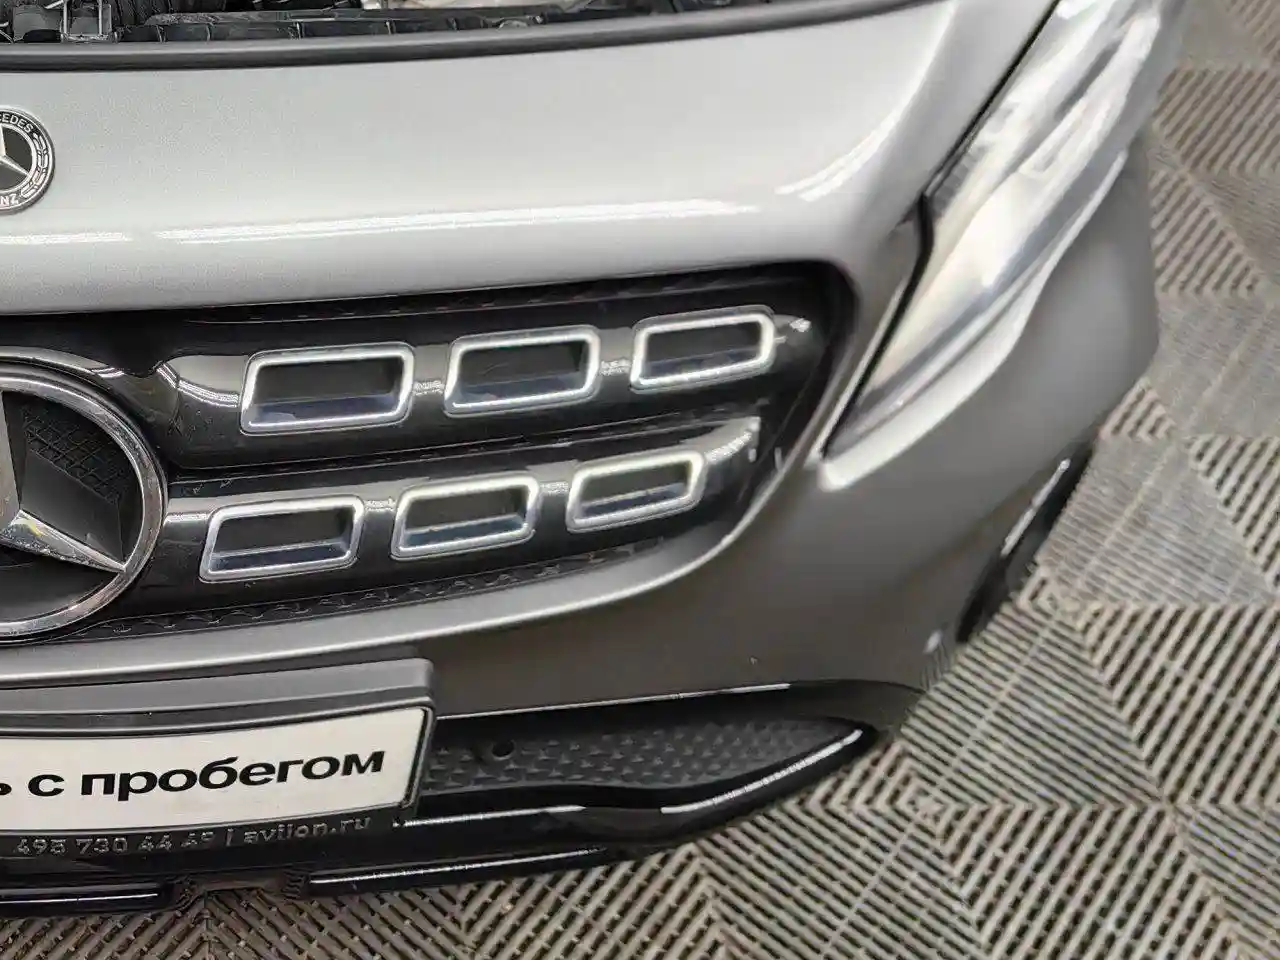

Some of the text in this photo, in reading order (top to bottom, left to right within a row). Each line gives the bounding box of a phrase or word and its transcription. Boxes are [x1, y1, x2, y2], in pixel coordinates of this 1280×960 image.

[27, 773, 65, 797] с
[80, 751, 385, 802] пробегом
[76, 836, 129, 855] 730
